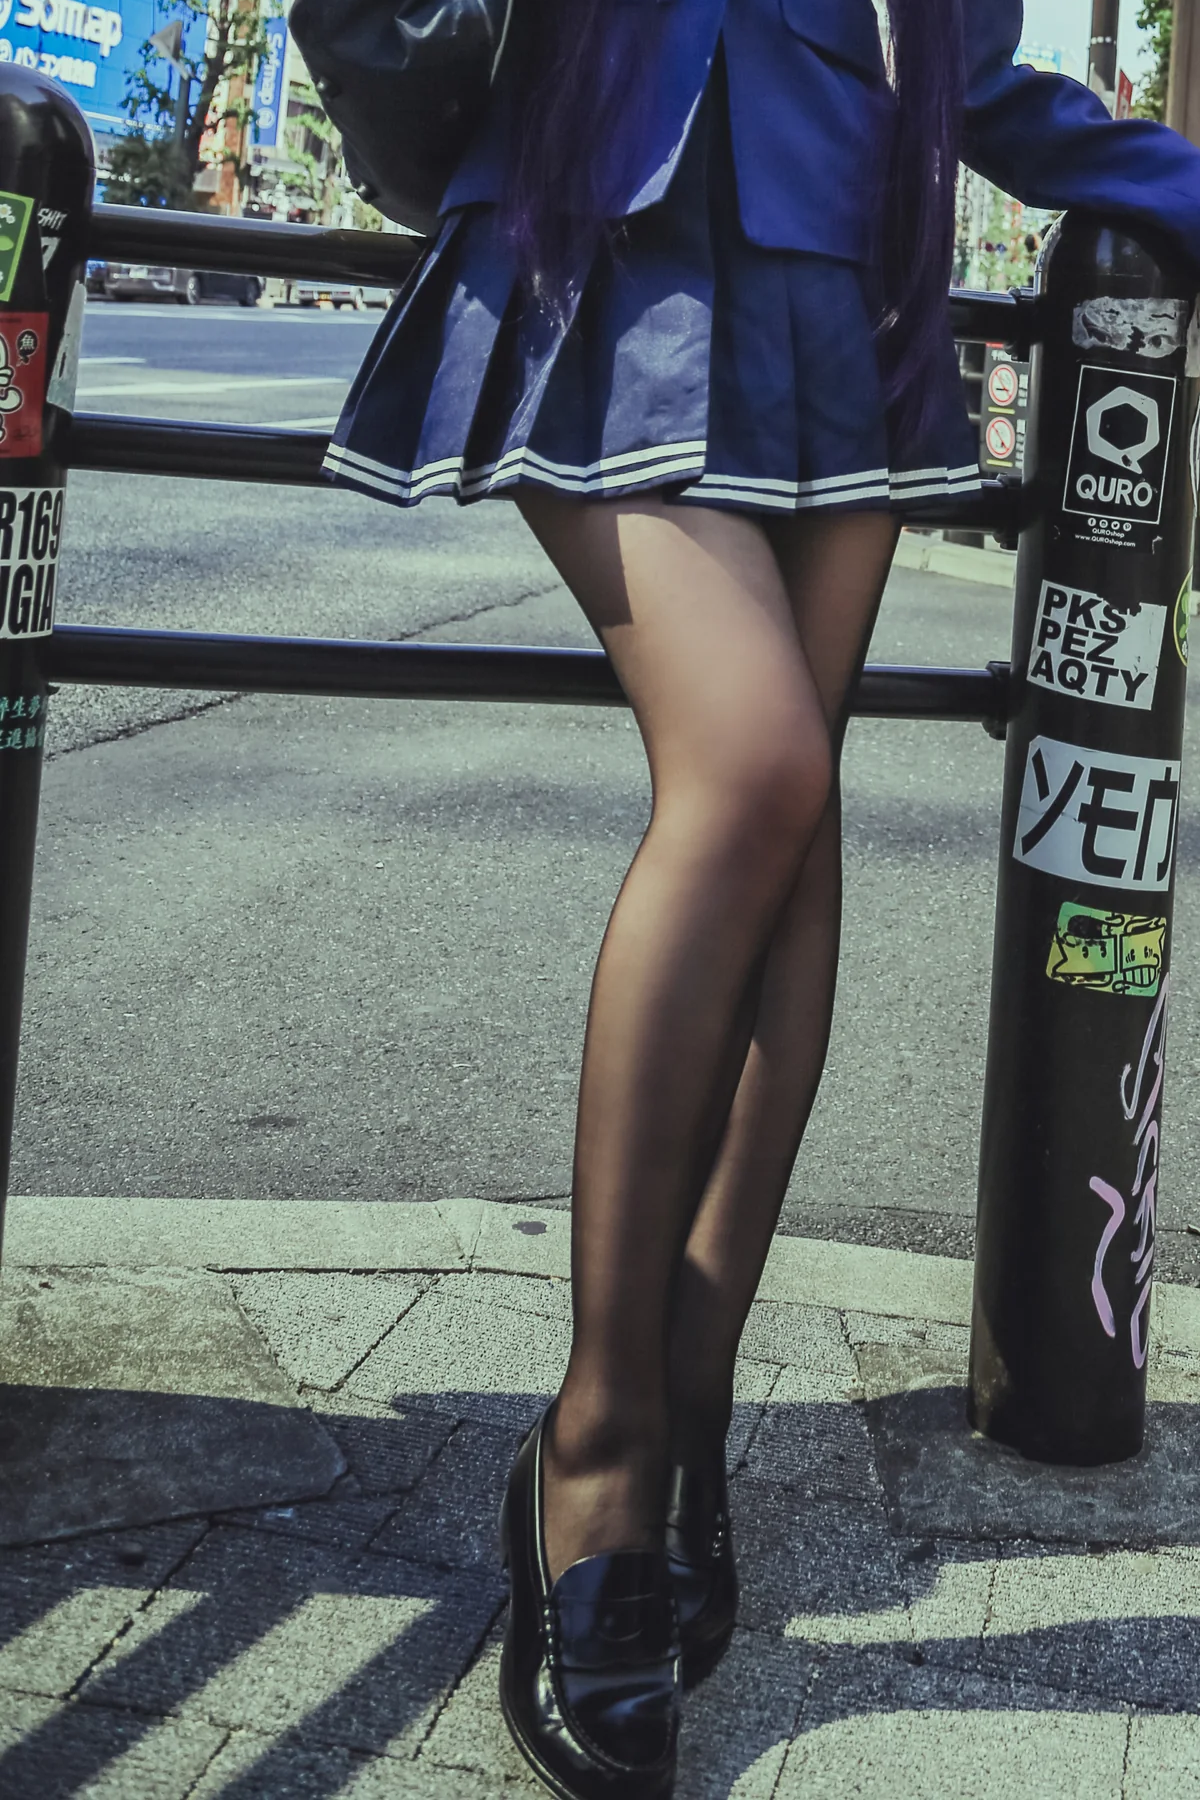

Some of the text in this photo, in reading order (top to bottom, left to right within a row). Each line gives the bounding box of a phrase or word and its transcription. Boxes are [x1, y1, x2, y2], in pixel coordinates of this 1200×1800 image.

[258, 33, 284, 106] Sofmap
[1076, 474, 1153, 507] QURO
[1075, 533, 1136, 548] www.QUROshop.com
[1092, 527, 1125, 539] QUROshop
[1042, 586, 1127, 634] PKS
[1037, 616, 1119, 666] PEZ
[1030, 650, 1149, 703] AQTY
